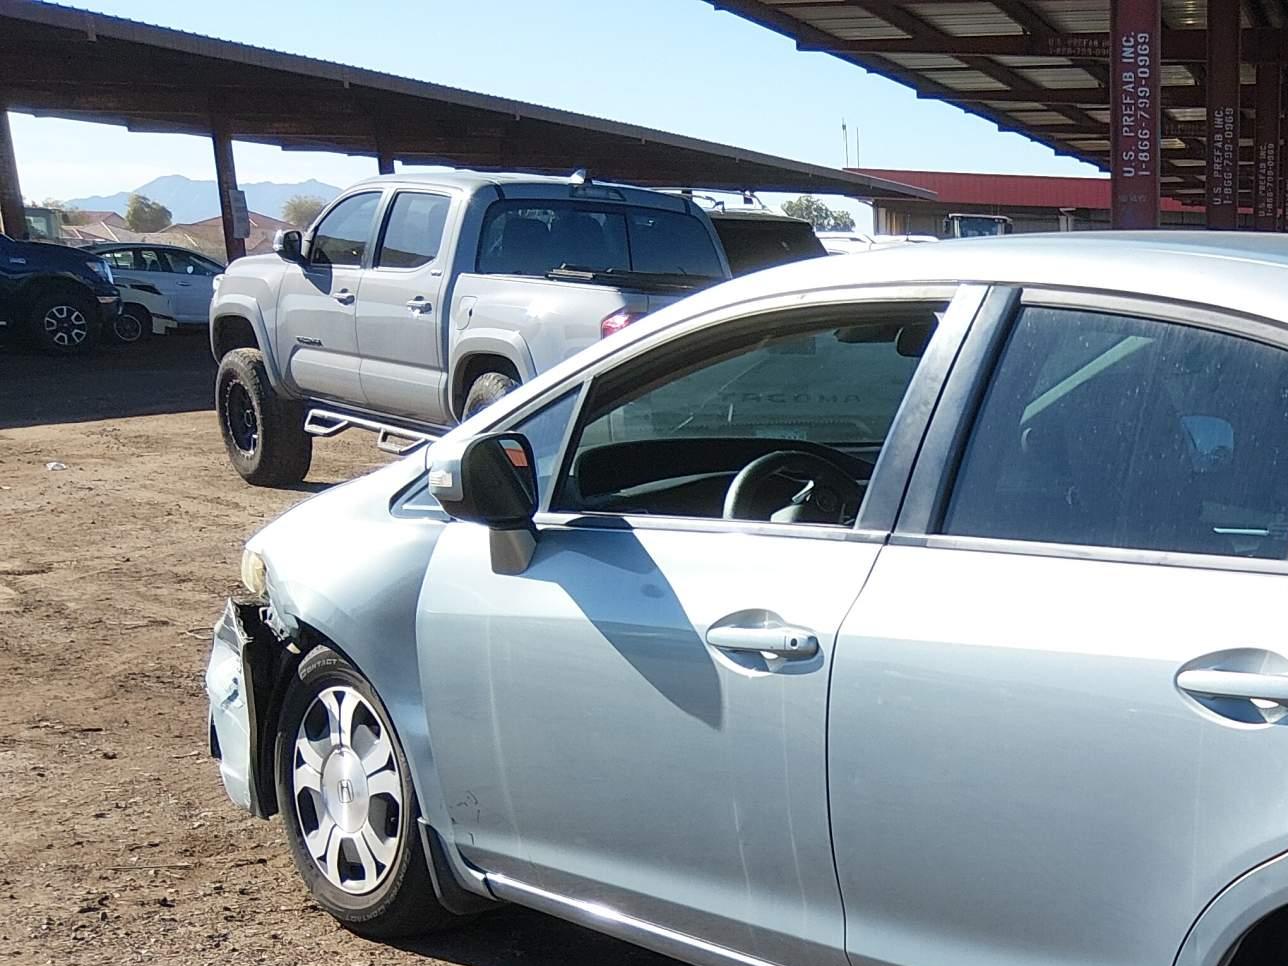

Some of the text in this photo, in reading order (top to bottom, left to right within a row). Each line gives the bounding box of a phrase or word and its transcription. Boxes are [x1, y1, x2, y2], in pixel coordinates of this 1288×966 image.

[1121, 31, 1135, 63] INC.
[1122, 71, 1135, 136] PREFAB
[1137, 32, 1150, 176] 1-866-799-0969
[1122, 146, 1135, 177] U.S.
[1213, 133, 1223, 178] PREFAB
